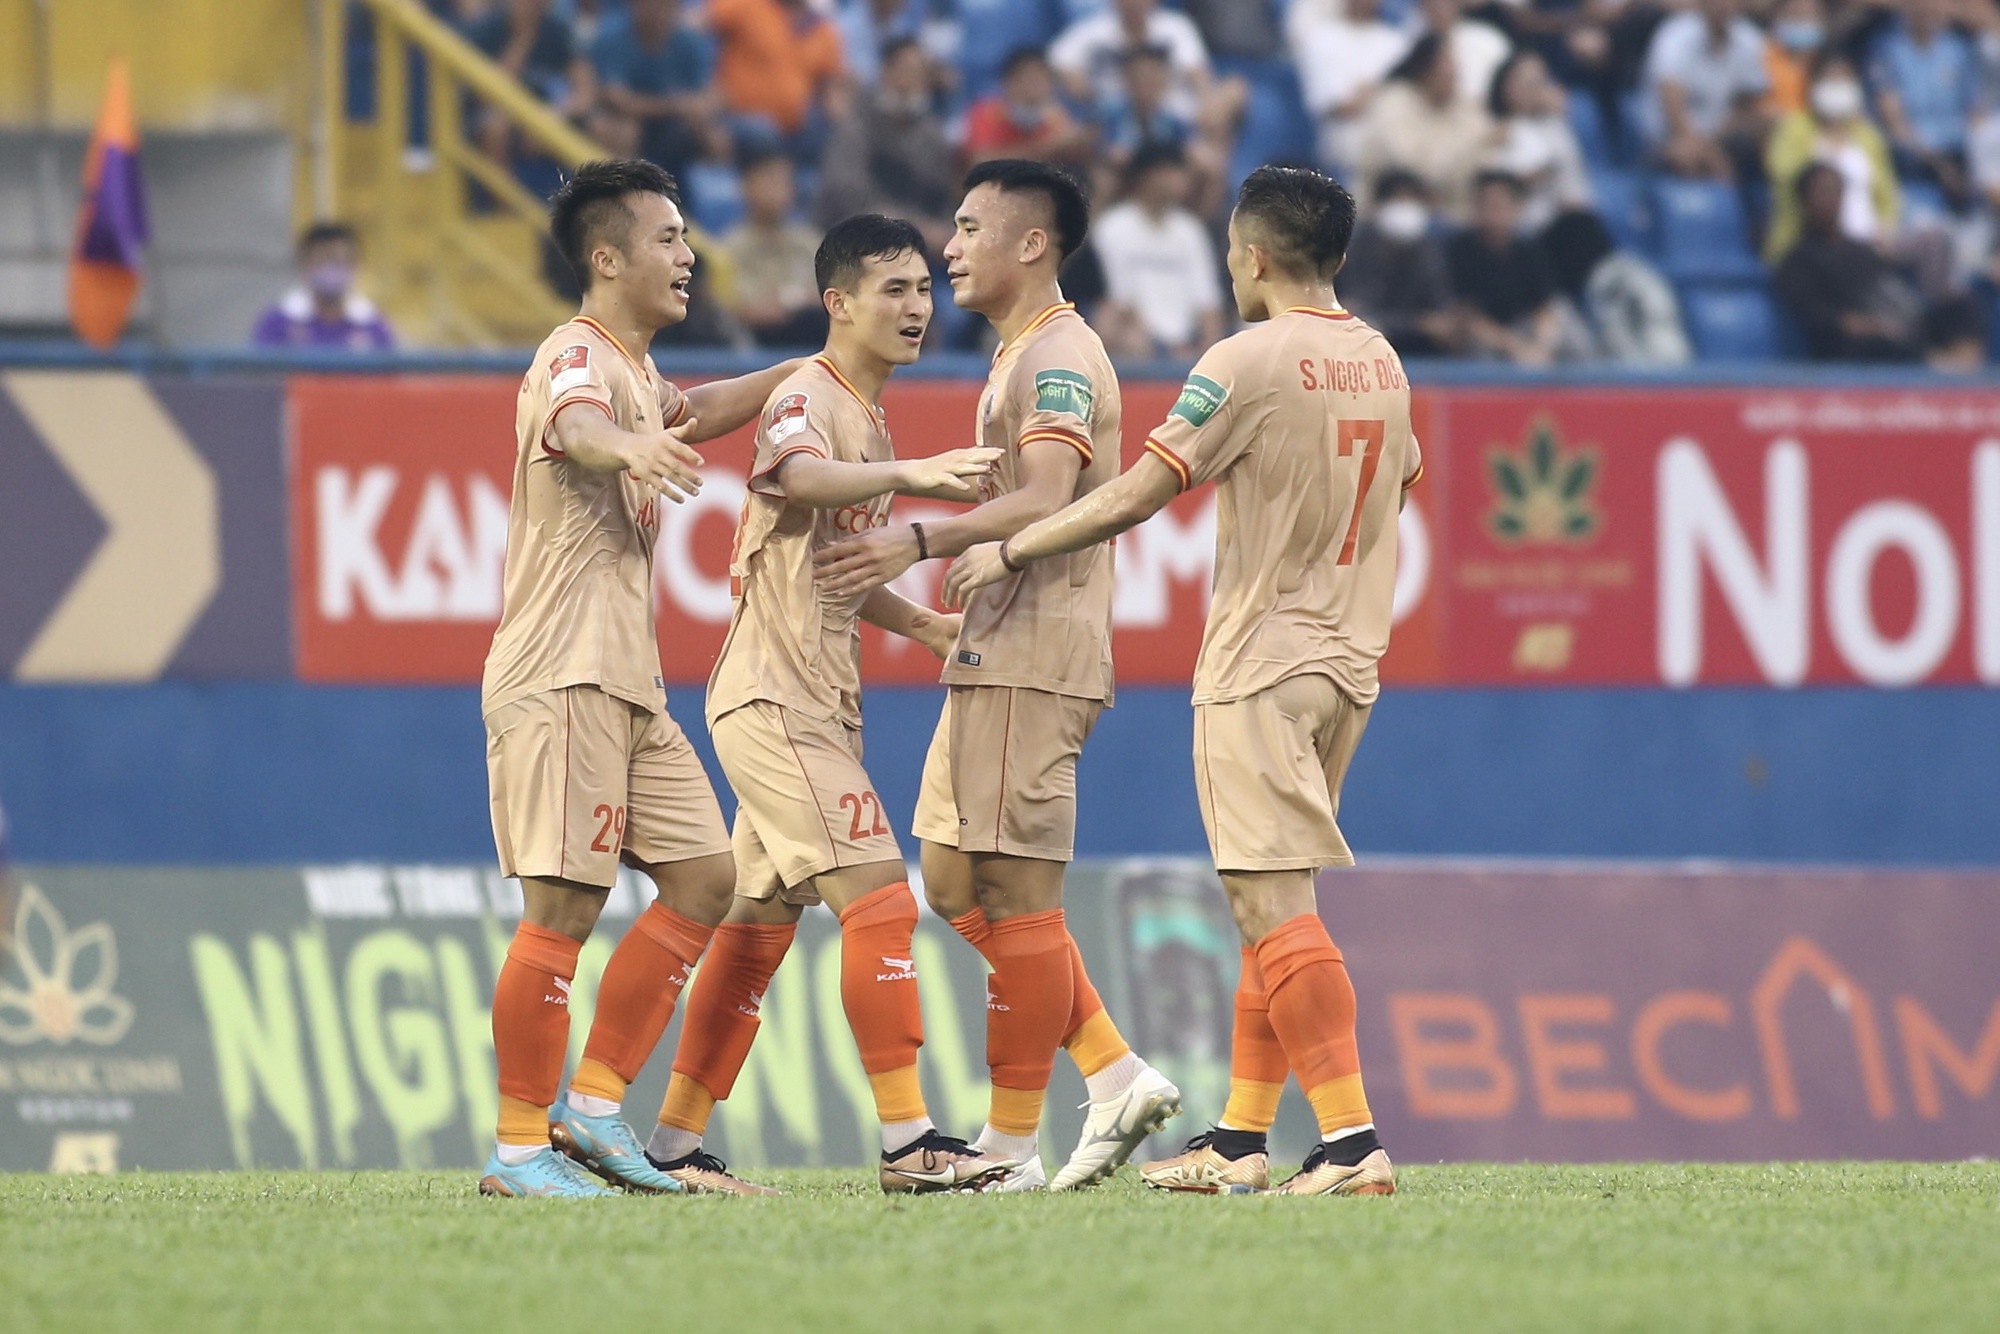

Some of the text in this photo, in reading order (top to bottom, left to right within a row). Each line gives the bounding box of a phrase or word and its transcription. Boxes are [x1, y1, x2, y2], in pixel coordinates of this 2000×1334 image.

[1187, 392, 1214, 415] WOLF
[1299, 358, 1371, 400] S.NGỌC
[1336, 419, 1385, 566] 7
[591, 803, 625, 854] 29
[839, 790, 888, 841] 22
